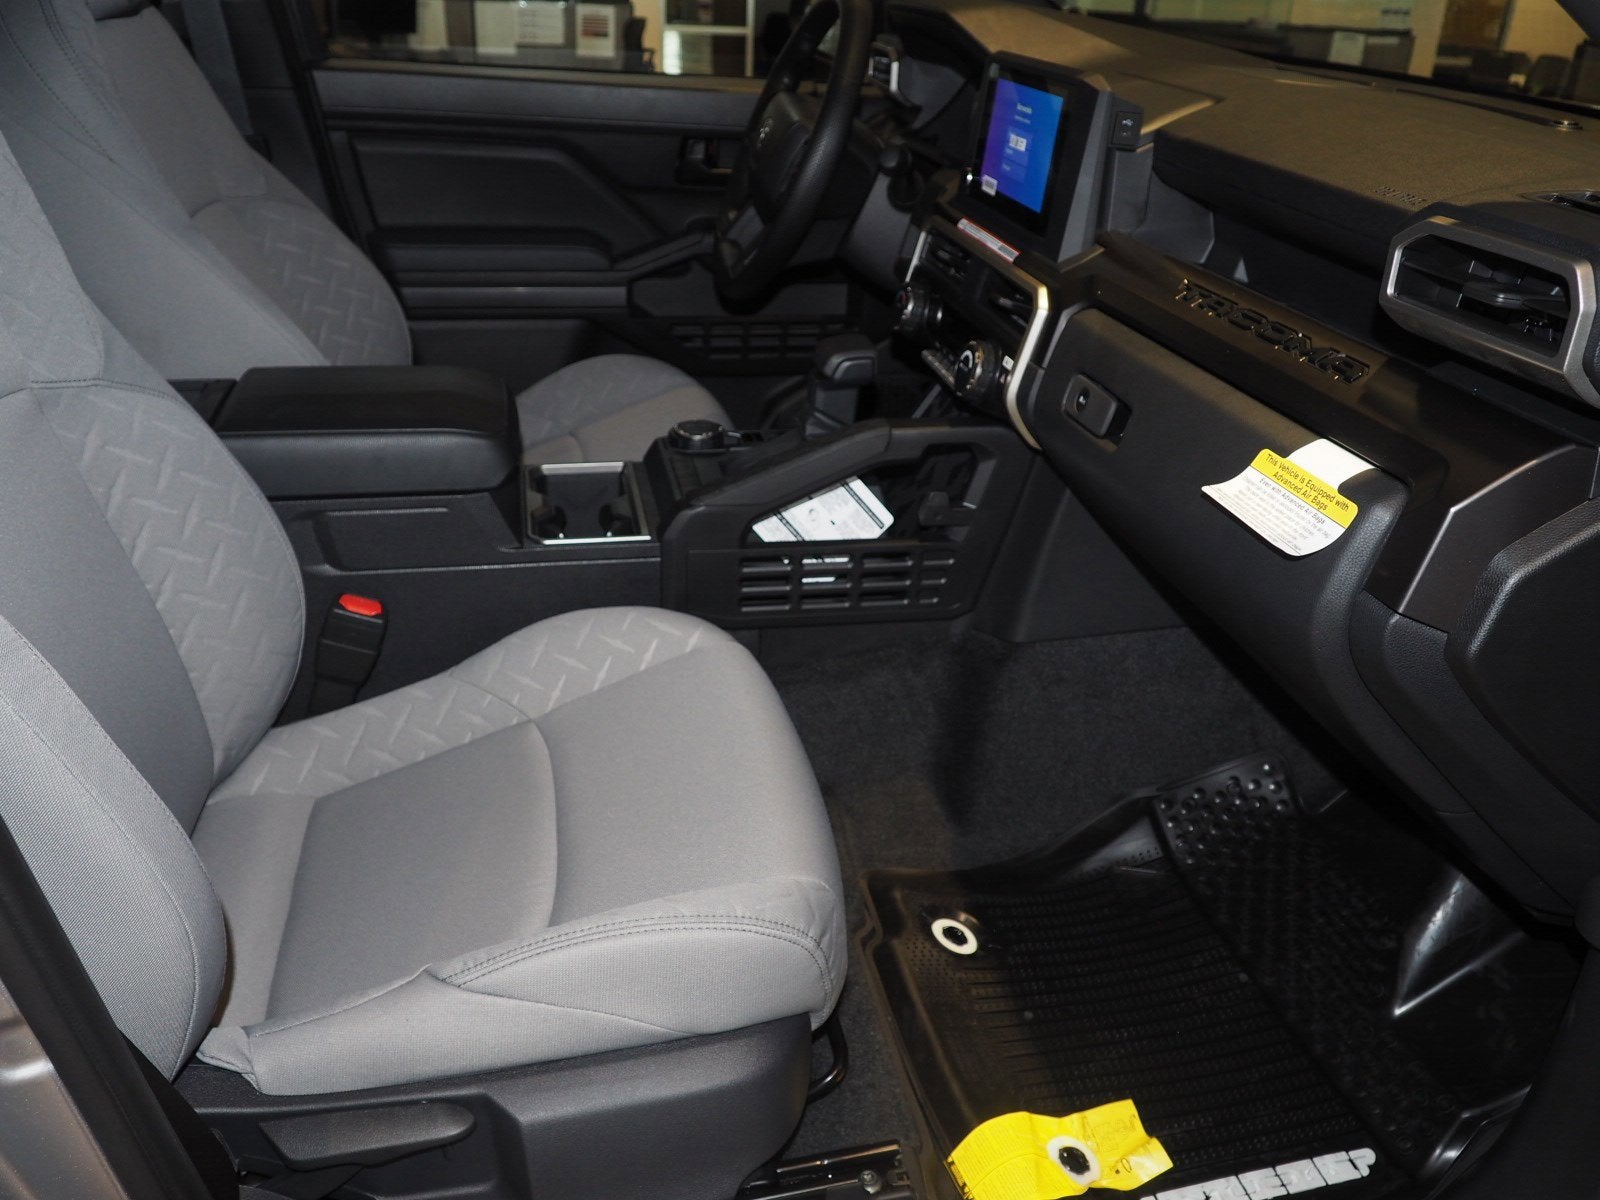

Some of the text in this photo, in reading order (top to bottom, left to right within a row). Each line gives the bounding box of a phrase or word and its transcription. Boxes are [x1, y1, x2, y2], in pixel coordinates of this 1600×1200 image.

[1265, 453, 1279, 466] This
[1278, 461, 1300, 480] Vehicle
[1304, 478, 1336, 502] Equipped
[1334, 498, 1350, 512] with
[1272, 471, 1328, 511] Advanced Air Bags
